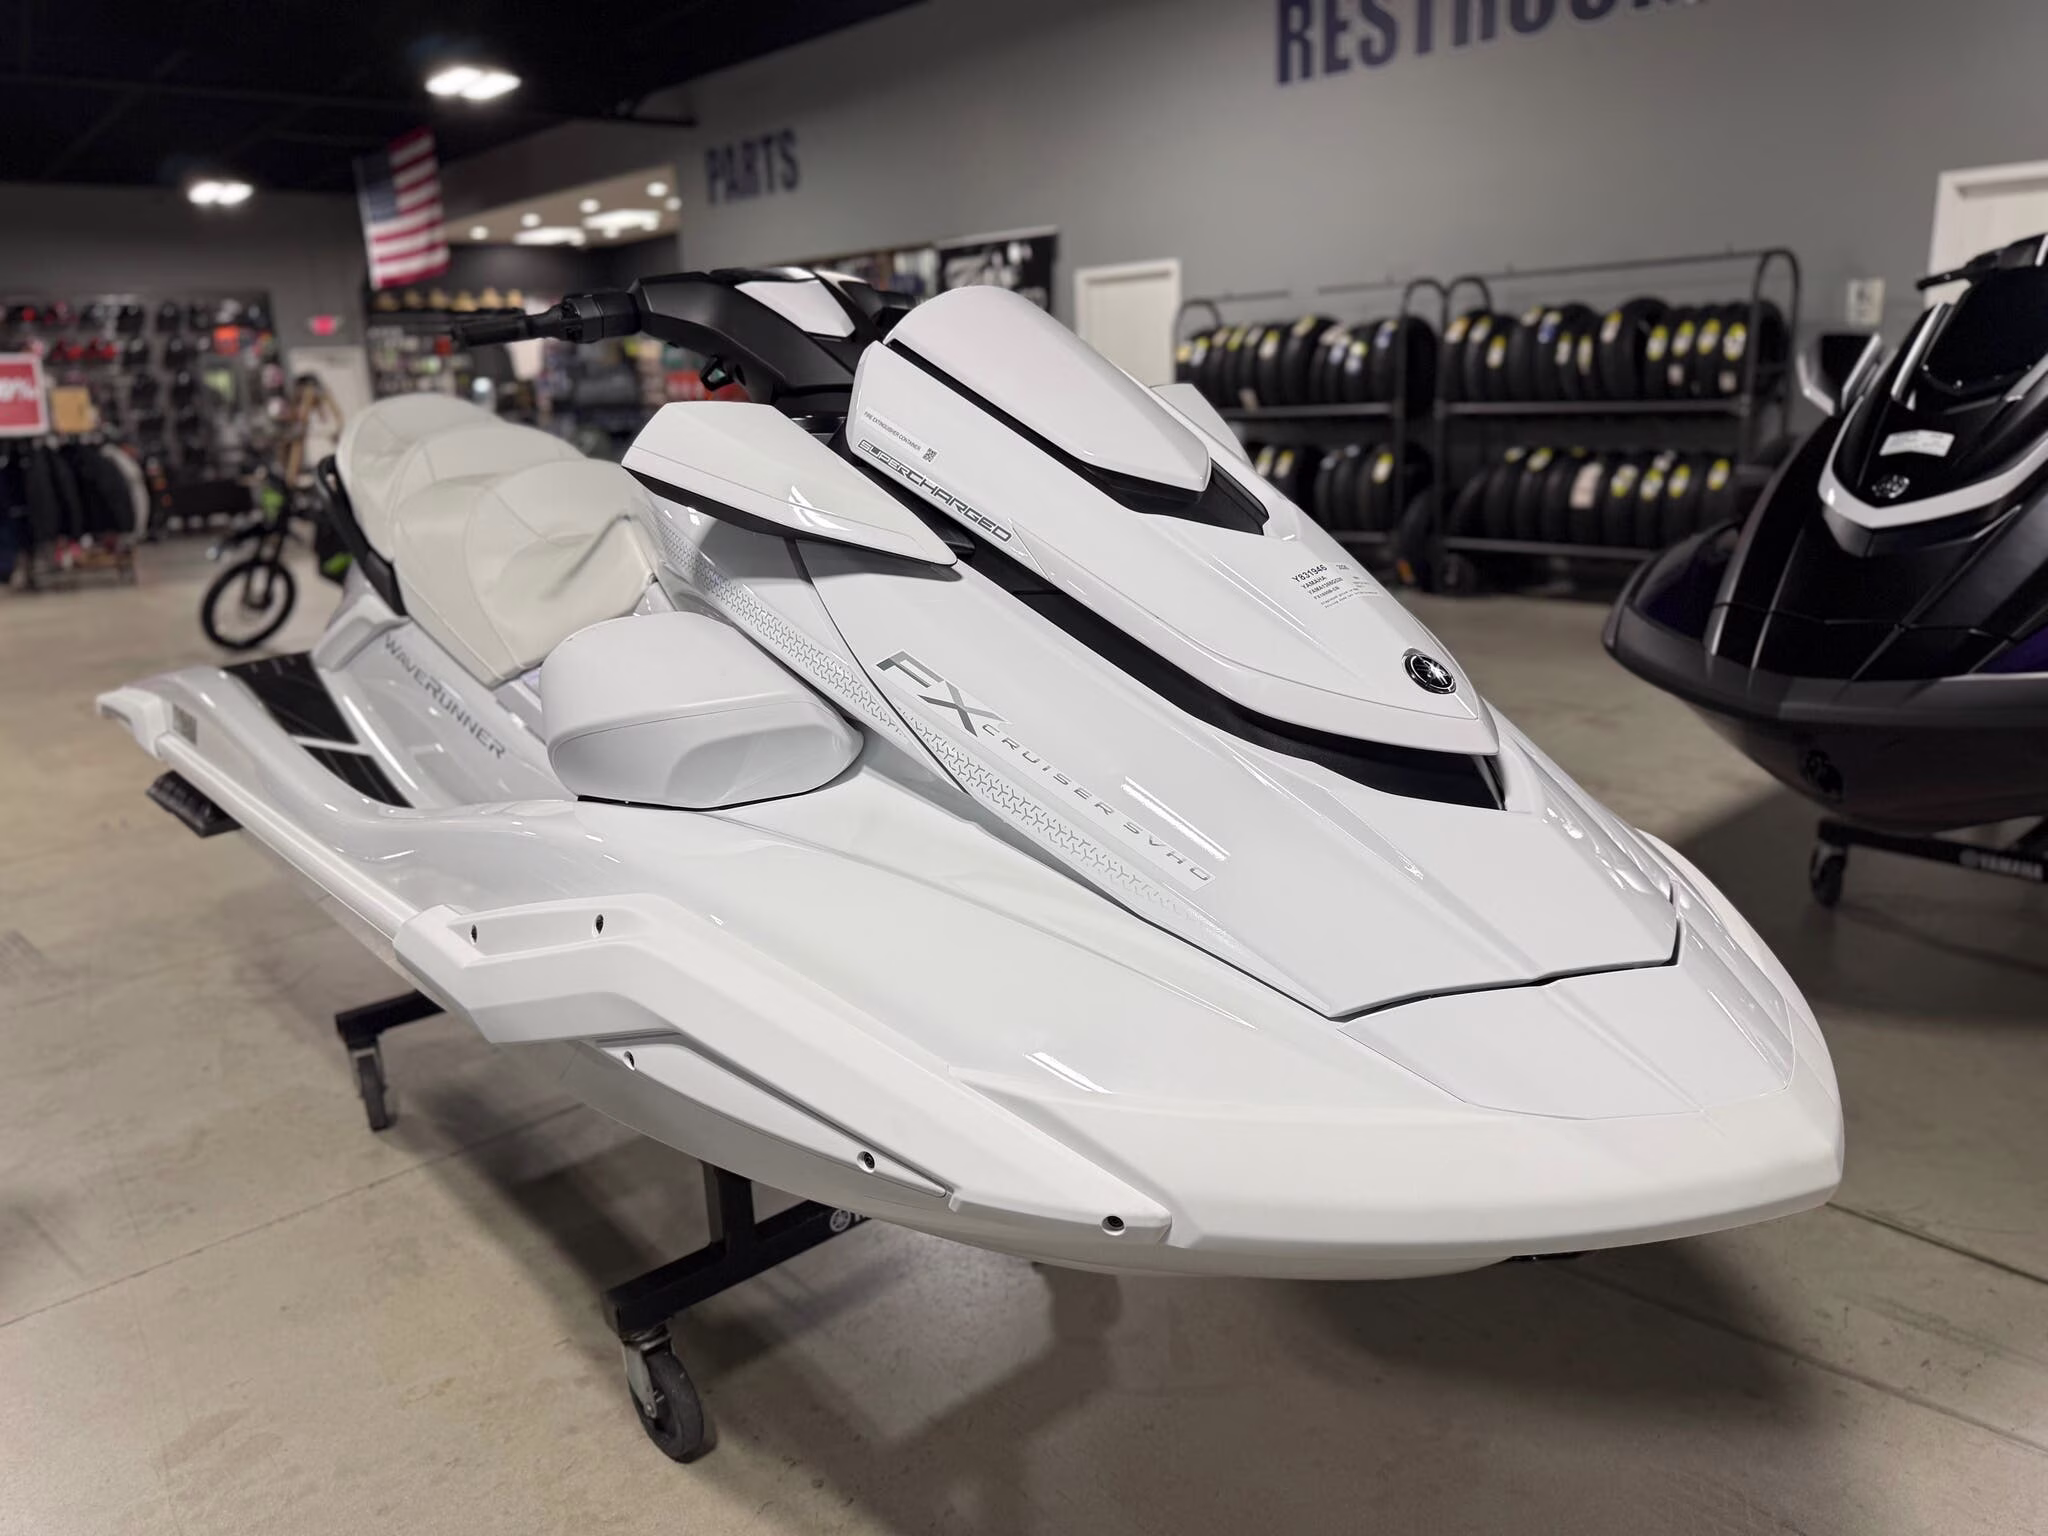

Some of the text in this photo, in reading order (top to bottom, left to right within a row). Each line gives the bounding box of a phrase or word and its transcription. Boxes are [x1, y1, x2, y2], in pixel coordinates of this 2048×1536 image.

[1277, 0, 1690, 84] REST
[704, 129, 799, 206] PARTS
[858, 440, 1012, 542] SUPERCHARGED
[1291, 564, 1327, 582] Y831946
[1301, 576, 1326, 589] YAMAHA
[385, 633, 505, 759] WAVERUNNER
[876, 651, 1210, 881] FX CRUISER SVHO
